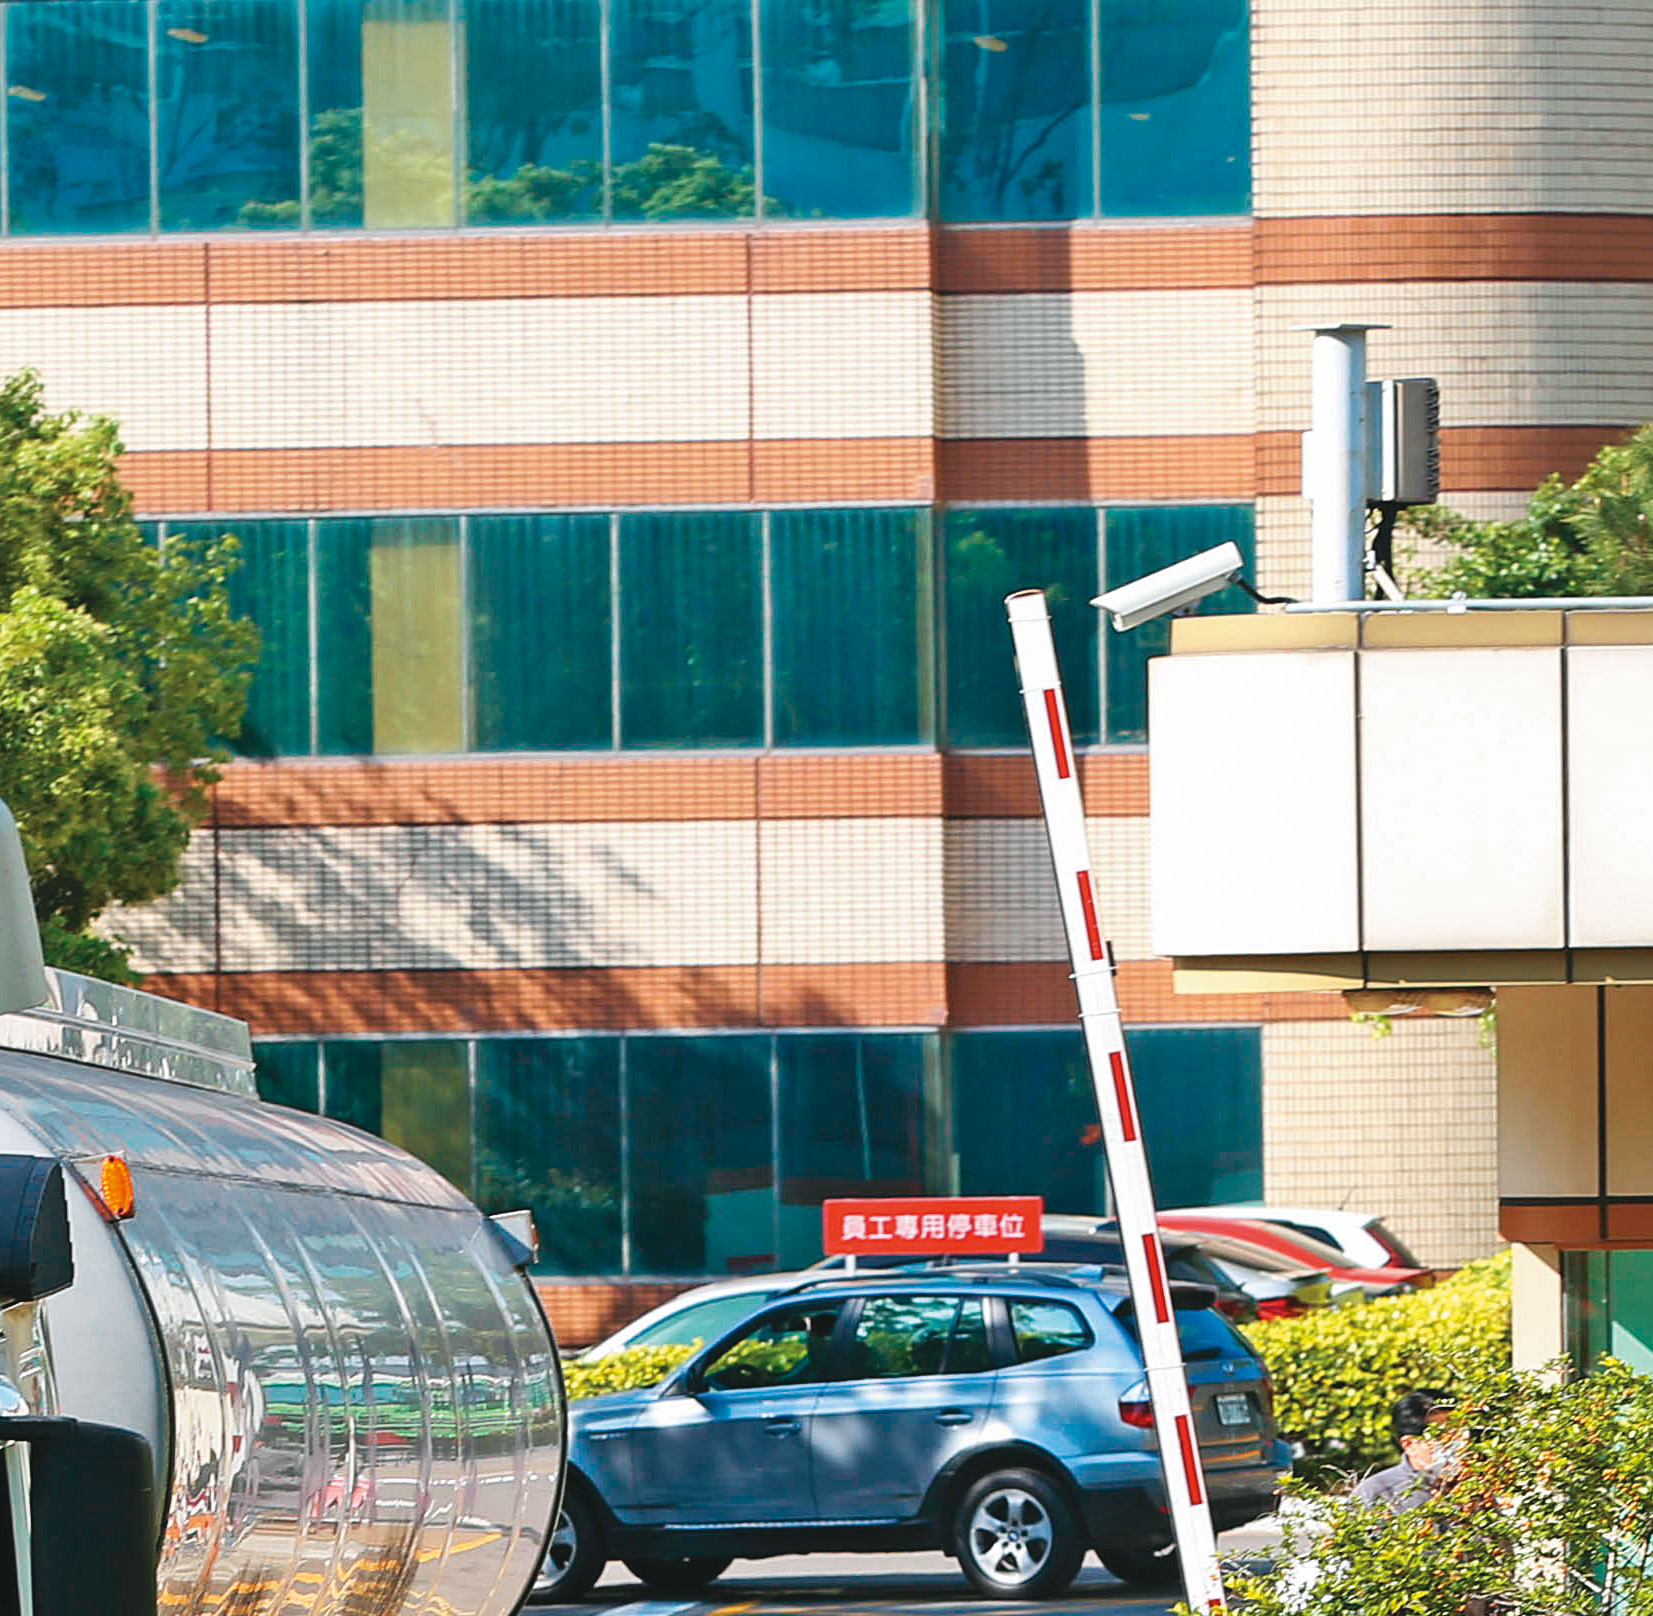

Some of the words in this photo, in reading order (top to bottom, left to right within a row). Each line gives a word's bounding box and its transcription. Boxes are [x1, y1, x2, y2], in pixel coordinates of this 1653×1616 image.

[841, 1213, 1026, 1241] 員工專用停車位
